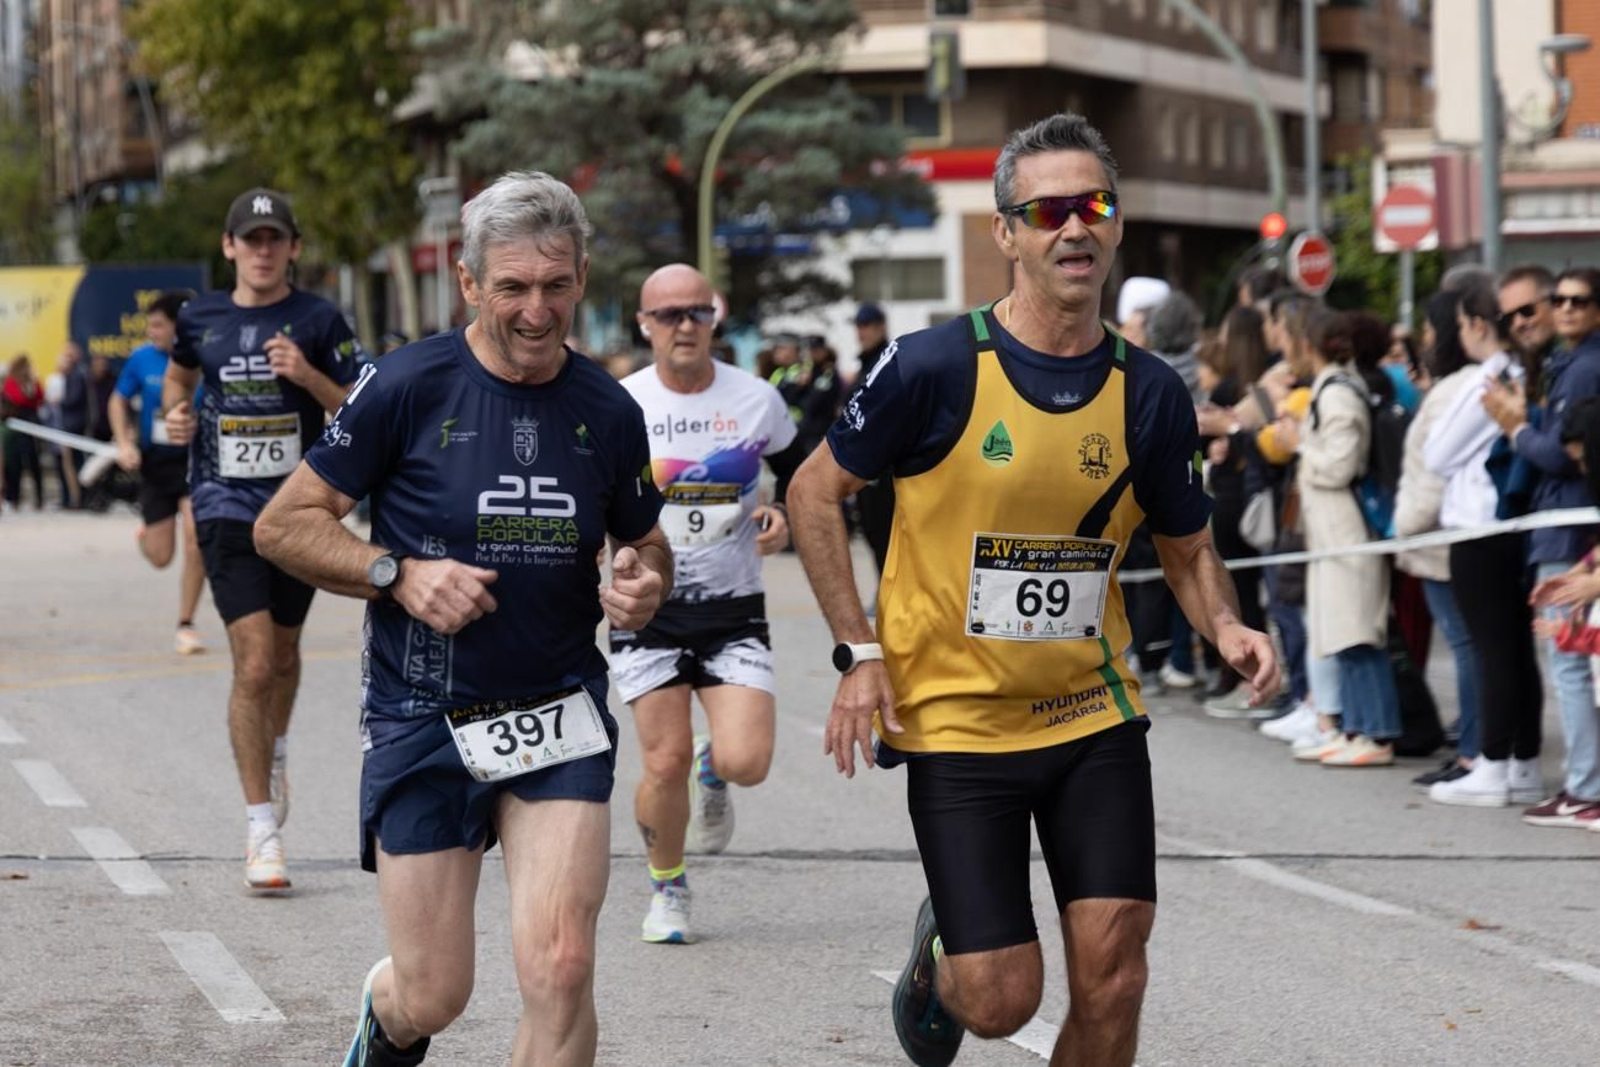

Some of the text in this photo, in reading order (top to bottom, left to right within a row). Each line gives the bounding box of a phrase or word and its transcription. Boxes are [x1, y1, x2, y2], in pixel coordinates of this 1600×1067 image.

[646, 411, 738, 443] alderón
[235, 440, 285, 463] 276
[477, 474, 577, 518] 25
[476, 515, 578, 531] CARRERA
[688, 509, 705, 534] 9
[421, 534, 448, 557] IES
[476, 528, 580, 545] POPULAR
[489, 543, 520, 552] gran
[1014, 540, 1063, 551] CARRERA
[1027, 549, 1056, 560] gran
[1060, 550, 1109, 560] caminata
[1015, 577, 1071, 619] 69
[1031, 684, 1110, 716] HYUNDAI
[1044, 701, 1109, 729] JACARSA
[486, 702, 565, 757] 397
